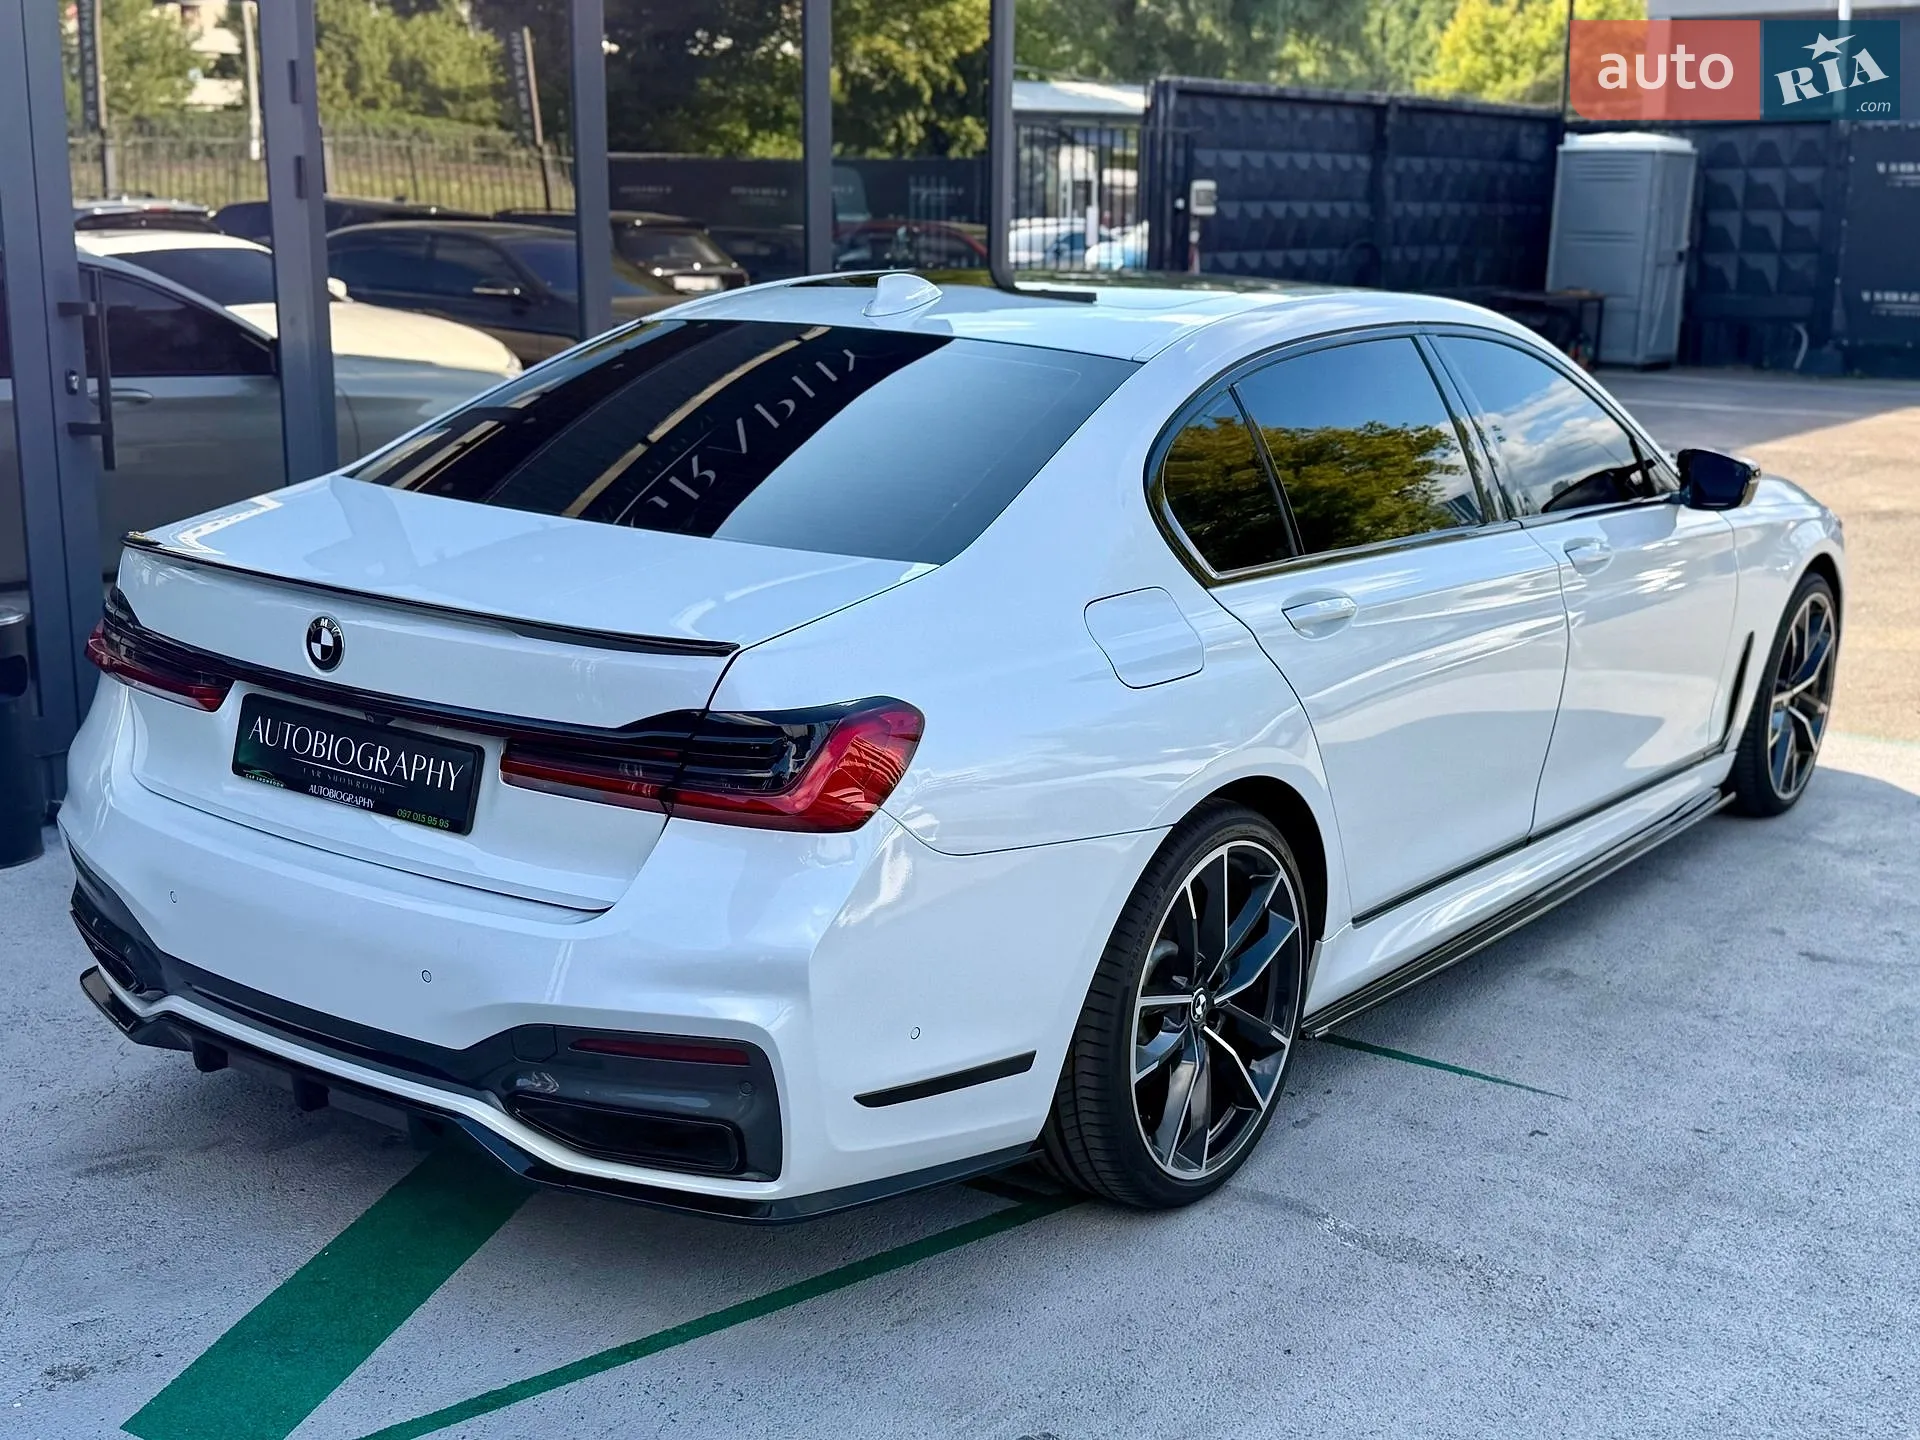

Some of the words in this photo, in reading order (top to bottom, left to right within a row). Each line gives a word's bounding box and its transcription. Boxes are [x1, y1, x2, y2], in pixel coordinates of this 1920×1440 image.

[248, 715, 464, 791] AUTOBIOGRAPHY
[308, 784, 375, 809] AUTOBIOGRAPHY
[396, 808, 412, 819] 097
[412, 812, 426, 823] 015
[427, 815, 438, 826] 95
[439, 818, 450, 828] 95
